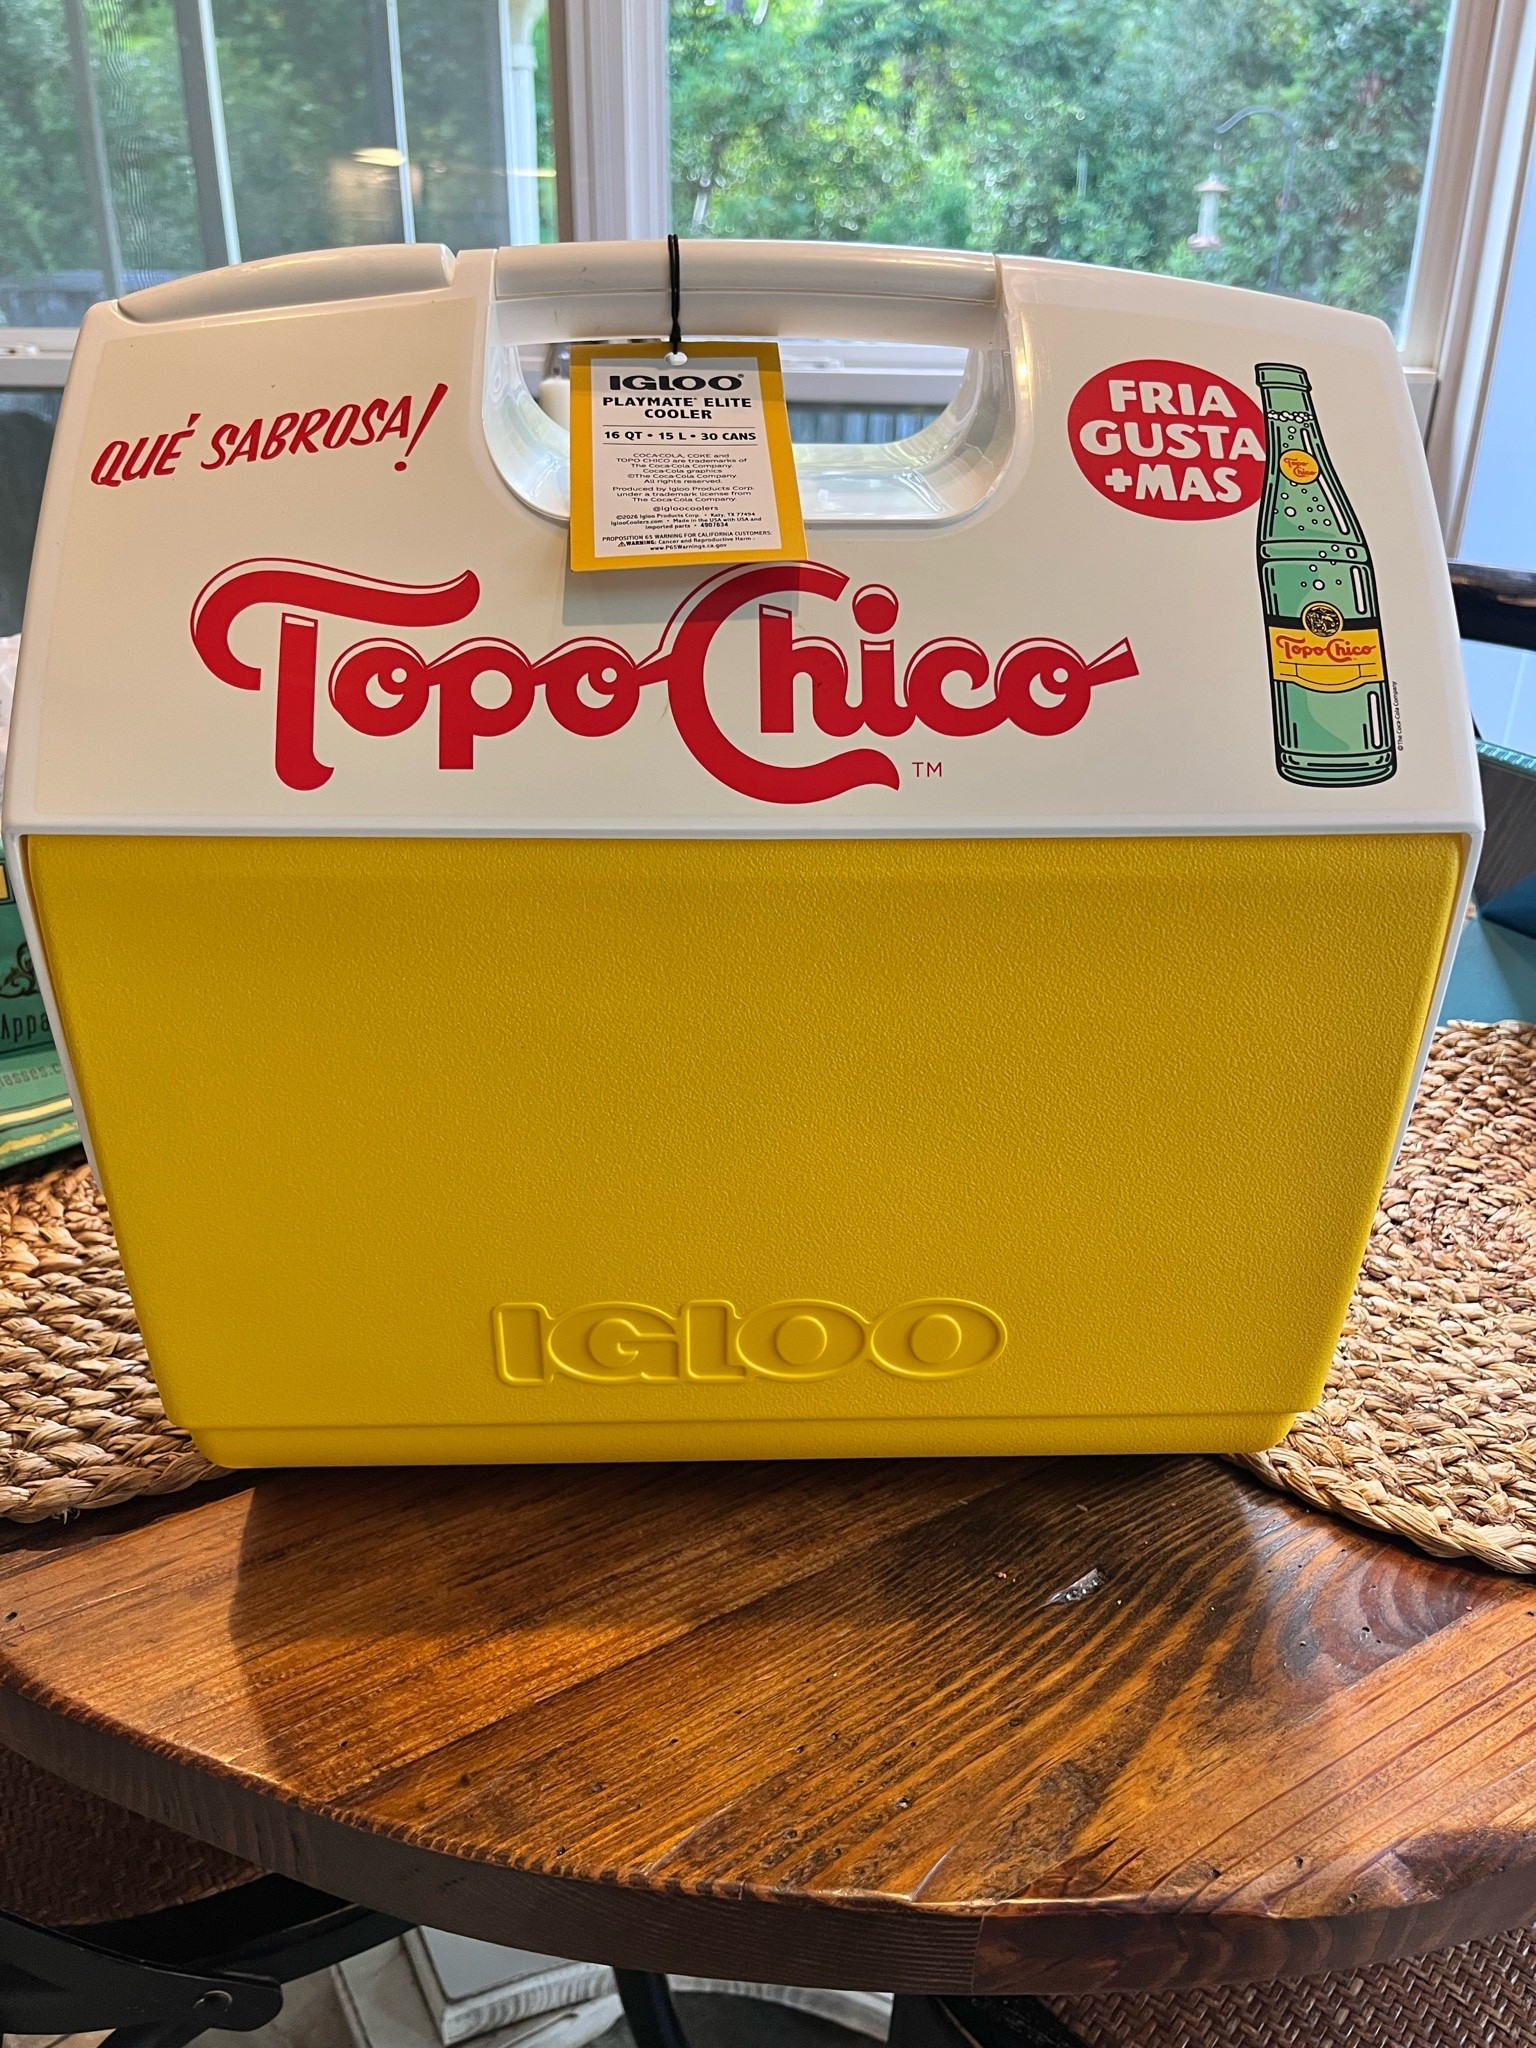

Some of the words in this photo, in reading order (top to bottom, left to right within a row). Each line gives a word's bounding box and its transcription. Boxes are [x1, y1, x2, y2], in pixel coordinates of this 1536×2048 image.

[645, 409, 712, 419] COOLER
[704, 398, 751, 408] ELITE
[1108, 380, 1238, 418] FRIA
[90, 412, 201, 488] QUÉ
[200, 382, 448, 472] SABROSA!
[624, 431, 642, 441] QT
[659, 432, 674, 440] 15
[679, 432, 686, 440] L
[701, 432, 718, 441] 30
[722, 432, 756, 441] CANS
[1080, 419, 1266, 462] GUSTA
[1276, 635, 1327, 659] Topo
[1326, 638, 1376, 662] Chico
[190, 557, 667, 792] Topo
[658, 560, 1140, 804] Chico
[494, 1297, 1008, 1386] IGLOO
